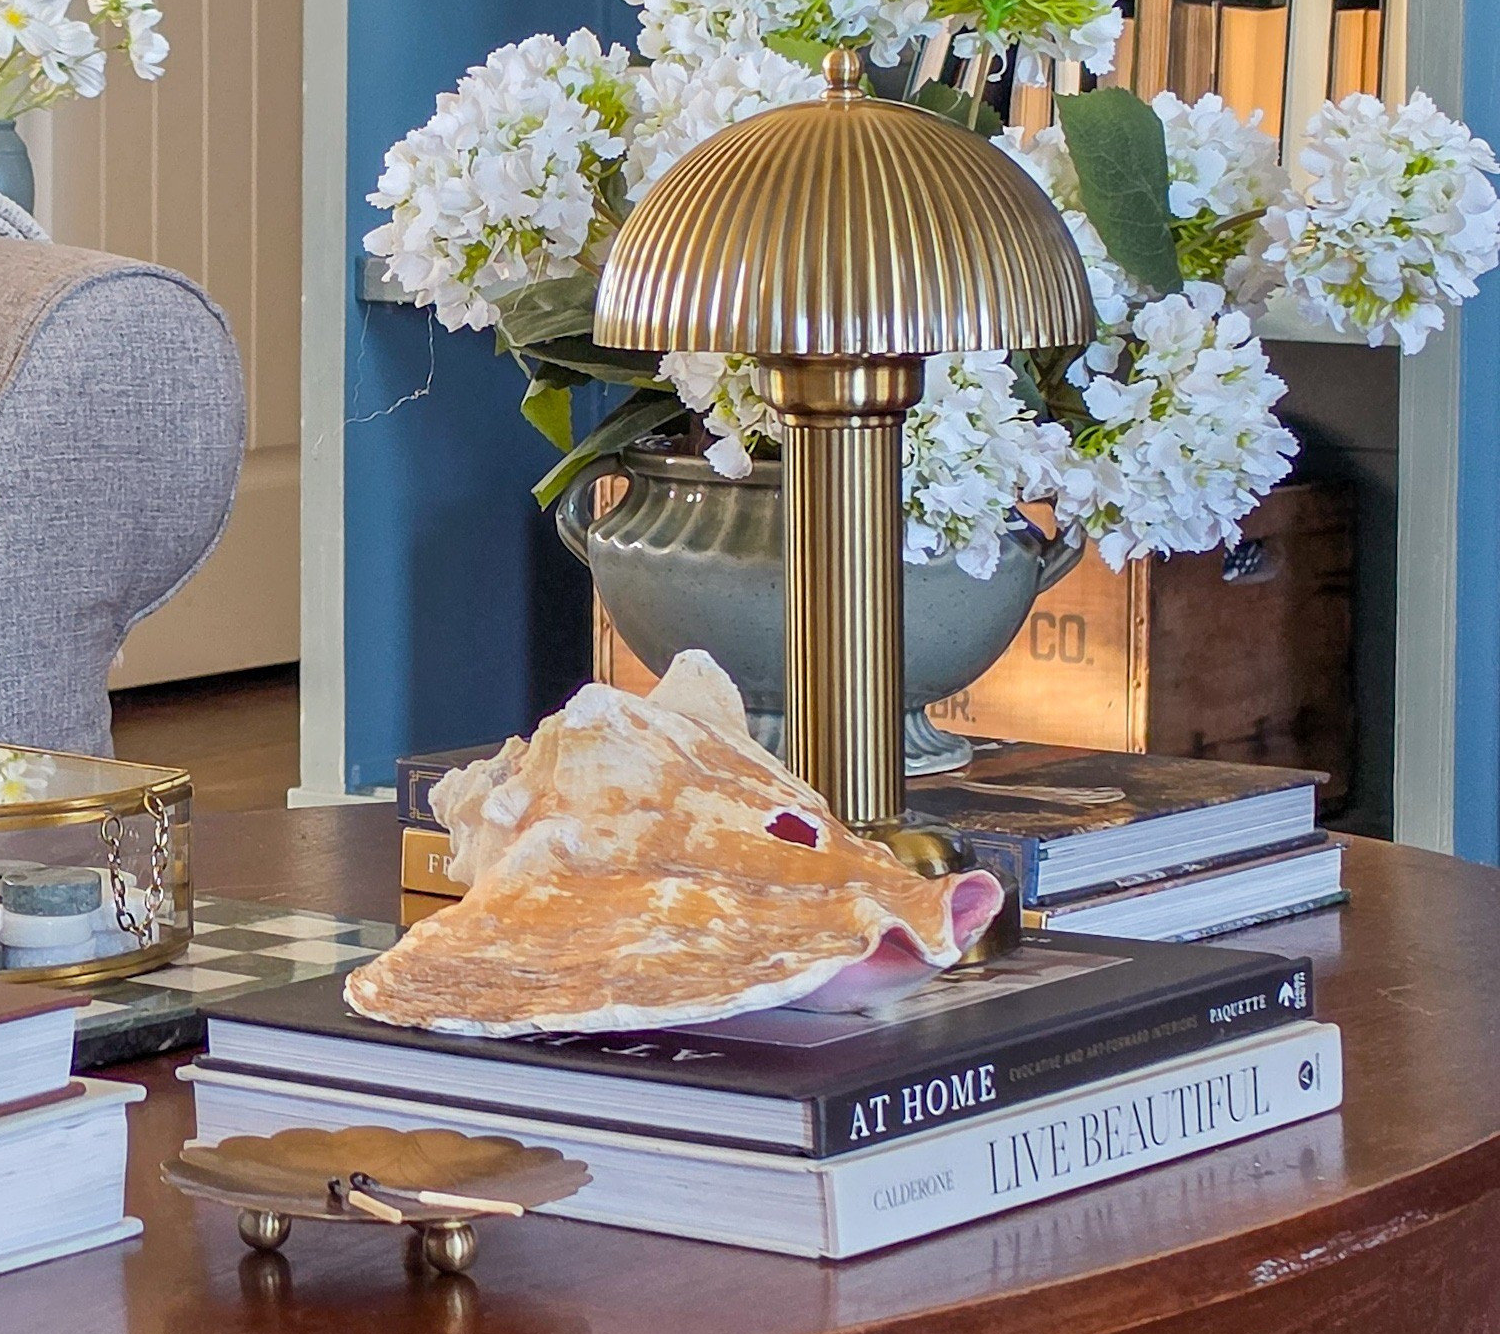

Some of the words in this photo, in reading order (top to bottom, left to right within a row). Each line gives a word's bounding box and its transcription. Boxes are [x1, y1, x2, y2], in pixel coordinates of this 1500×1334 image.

[1029, 610, 1095, 666] CO.
[1209, 993, 1268, 1024] PAQUETTE
[849, 1093, 891, 1141] AT
[901, 1063, 997, 1125] HOME
[986, 1120, 1071, 1195] LIVE
[1078, 1065, 1270, 1168] BEAUTIFUL
[873, 1168, 956, 1212] CALDERONE
